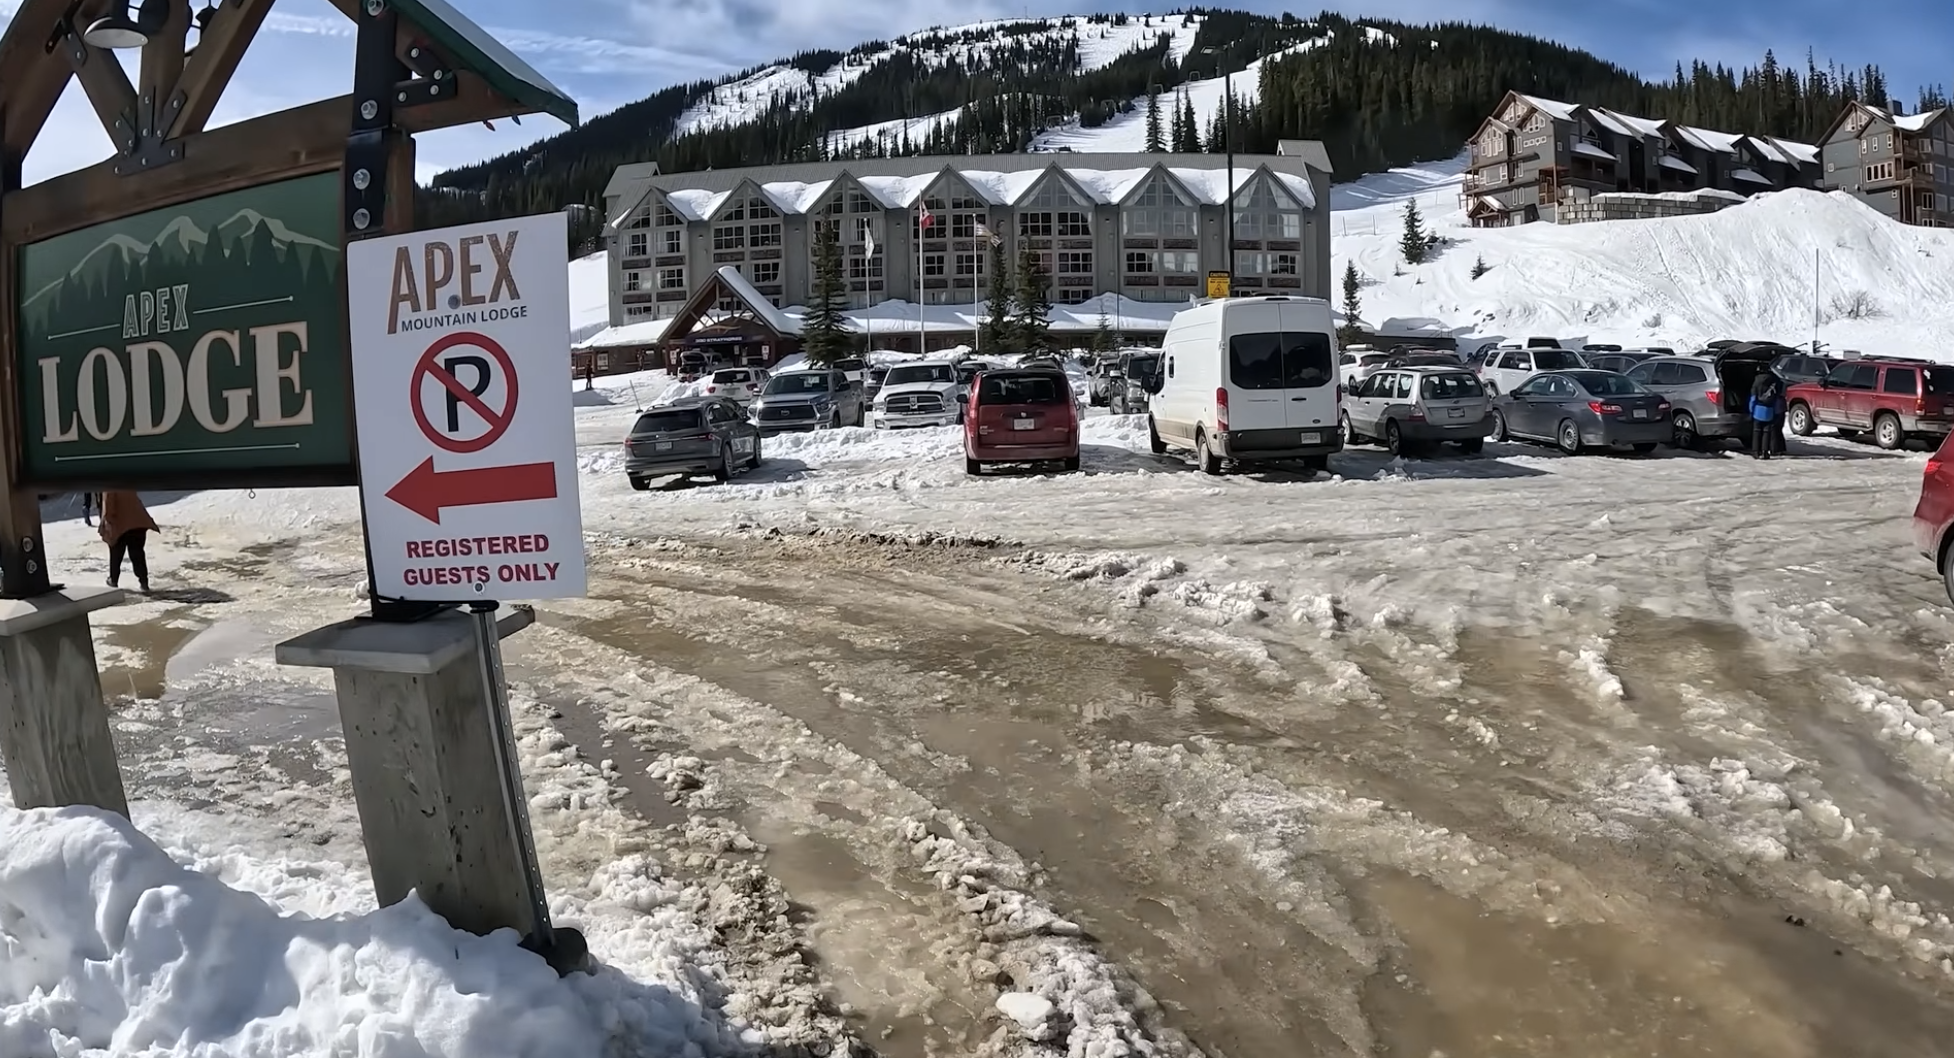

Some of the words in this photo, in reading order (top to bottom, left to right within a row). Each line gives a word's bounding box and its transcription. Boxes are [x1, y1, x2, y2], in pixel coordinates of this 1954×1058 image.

[387, 230, 521, 335] APEX
[122, 284, 189, 339] APEX
[401, 311, 477, 332] MOUNTAIN
[481, 305, 528, 322] LODGE
[38, 321, 313, 443] LODGE
[444, 356, 491, 432] P
[406, 534, 549, 558] REGISTERED
[403, 565, 490, 586] GUESTS
[497, 562, 560, 583] ONLY
